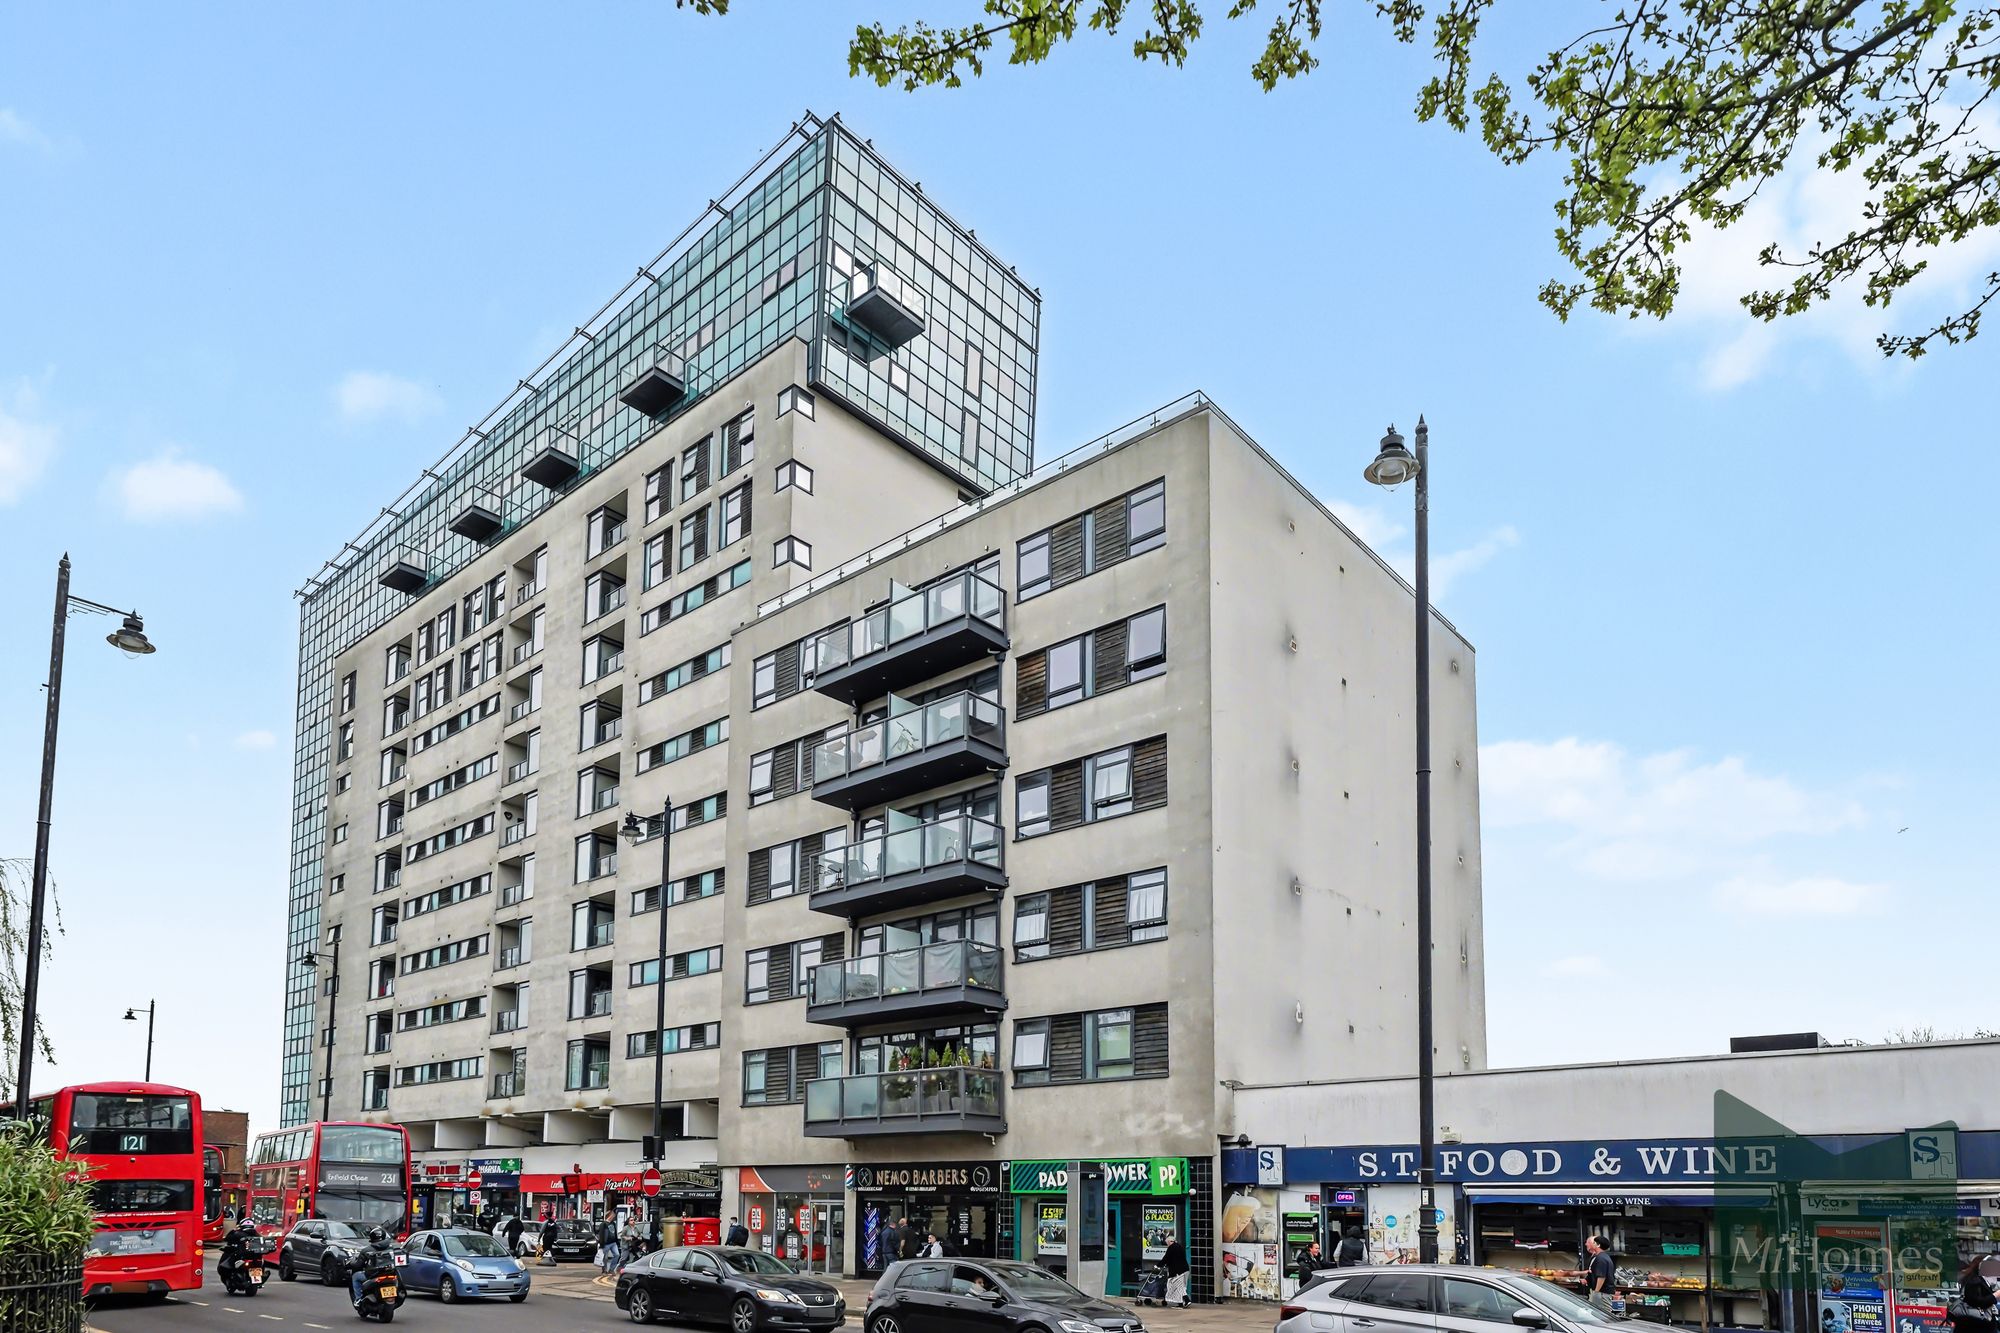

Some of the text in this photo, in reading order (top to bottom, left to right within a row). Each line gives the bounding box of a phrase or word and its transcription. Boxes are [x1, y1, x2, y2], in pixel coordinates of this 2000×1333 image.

[123, 1136, 143, 1150] 121
[1440, 1149, 1562, 1176] FOOD
[1588, 1147, 1621, 1175] &
[1636, 1145, 1777, 1175] WINE
[381, 1173, 396, 1184] 231
[622, 1175, 637, 1188] Hut
[876, 1168, 969, 1186] NEMO BARBERS
[1038, 1170, 1068, 1188] PAD
[1586, 1197, 1614, 1205] FOOD
[1615, 1197, 1623, 1205] &
[1807, 1197, 1839, 1208] Lyca
[1852, 1304, 1884, 1313] PHONE
